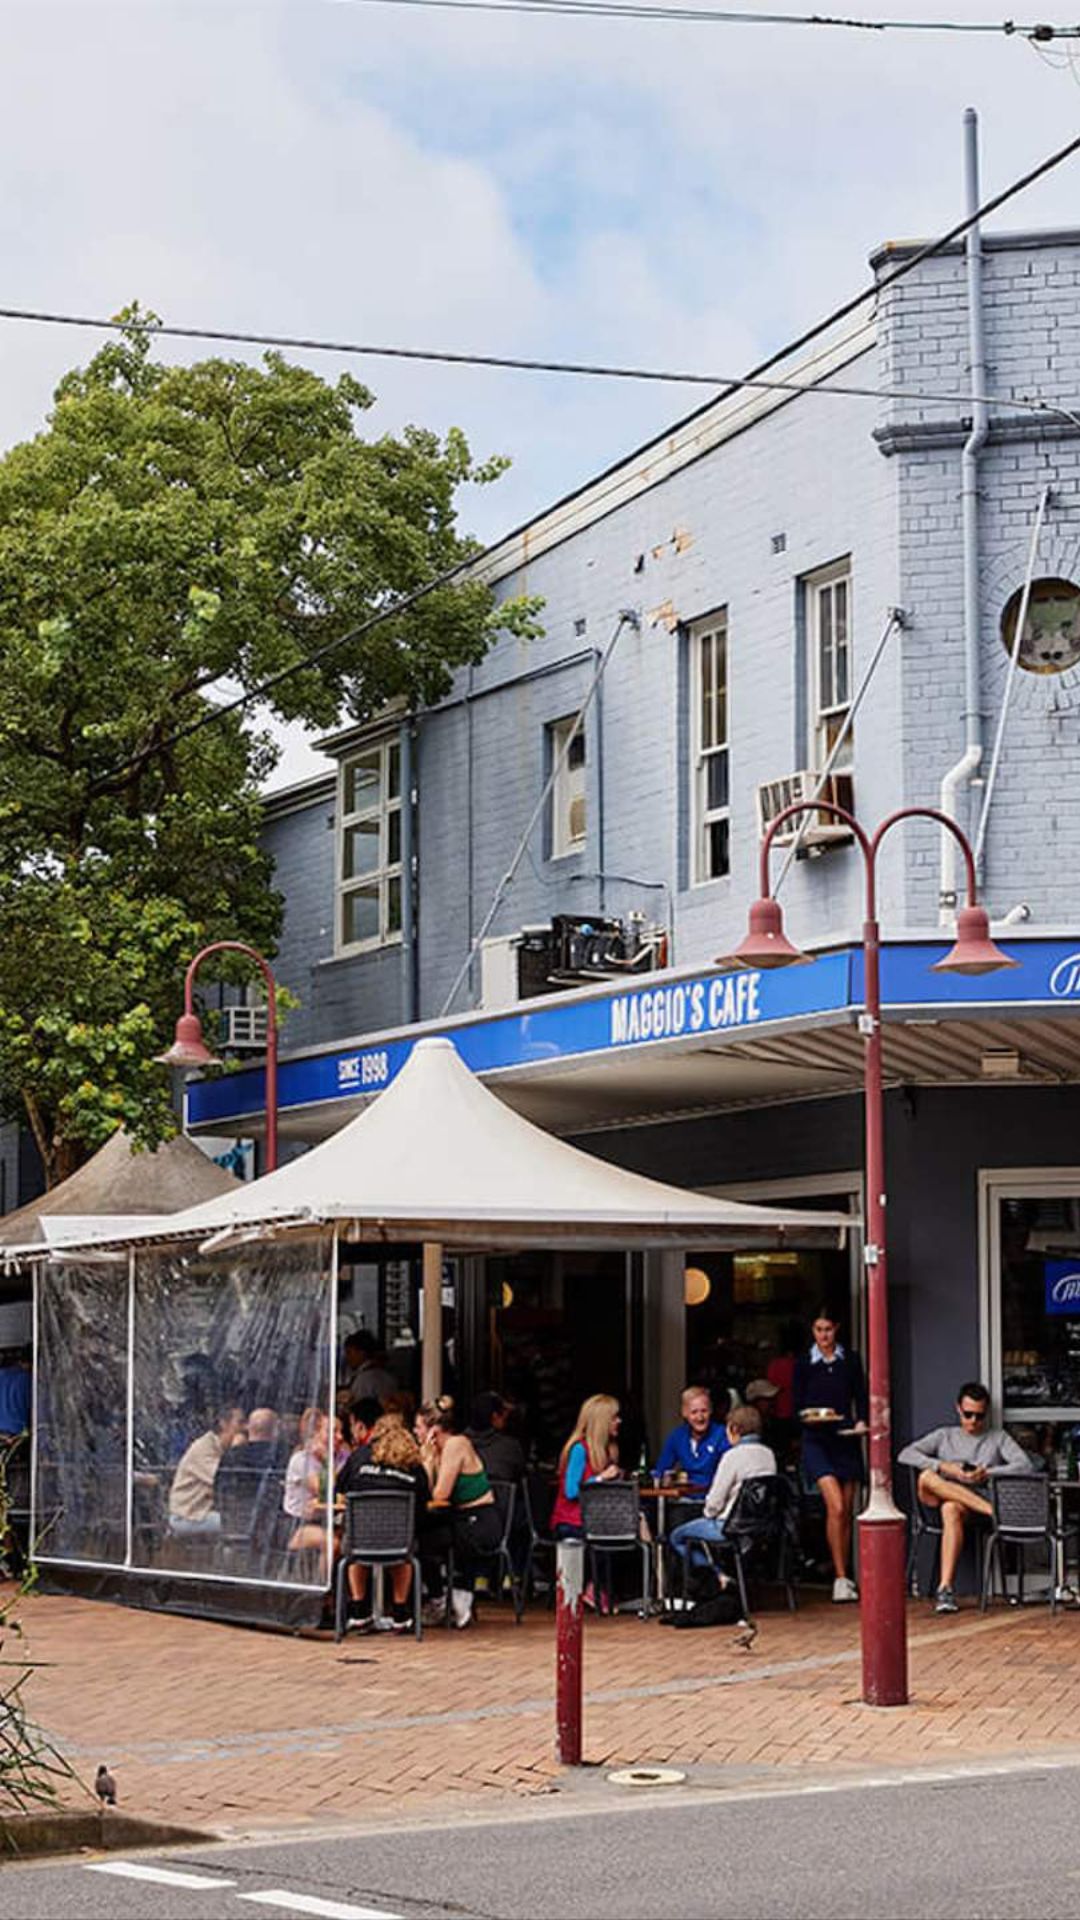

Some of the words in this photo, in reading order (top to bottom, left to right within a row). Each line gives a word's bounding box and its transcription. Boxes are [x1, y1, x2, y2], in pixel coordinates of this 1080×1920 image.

[611, 984, 704, 1044] MAGGIO'S
[709, 972, 761, 1027] CAFE
[338, 1057, 360, 1080] SINCE
[362, 1051, 388, 1085] 1998
